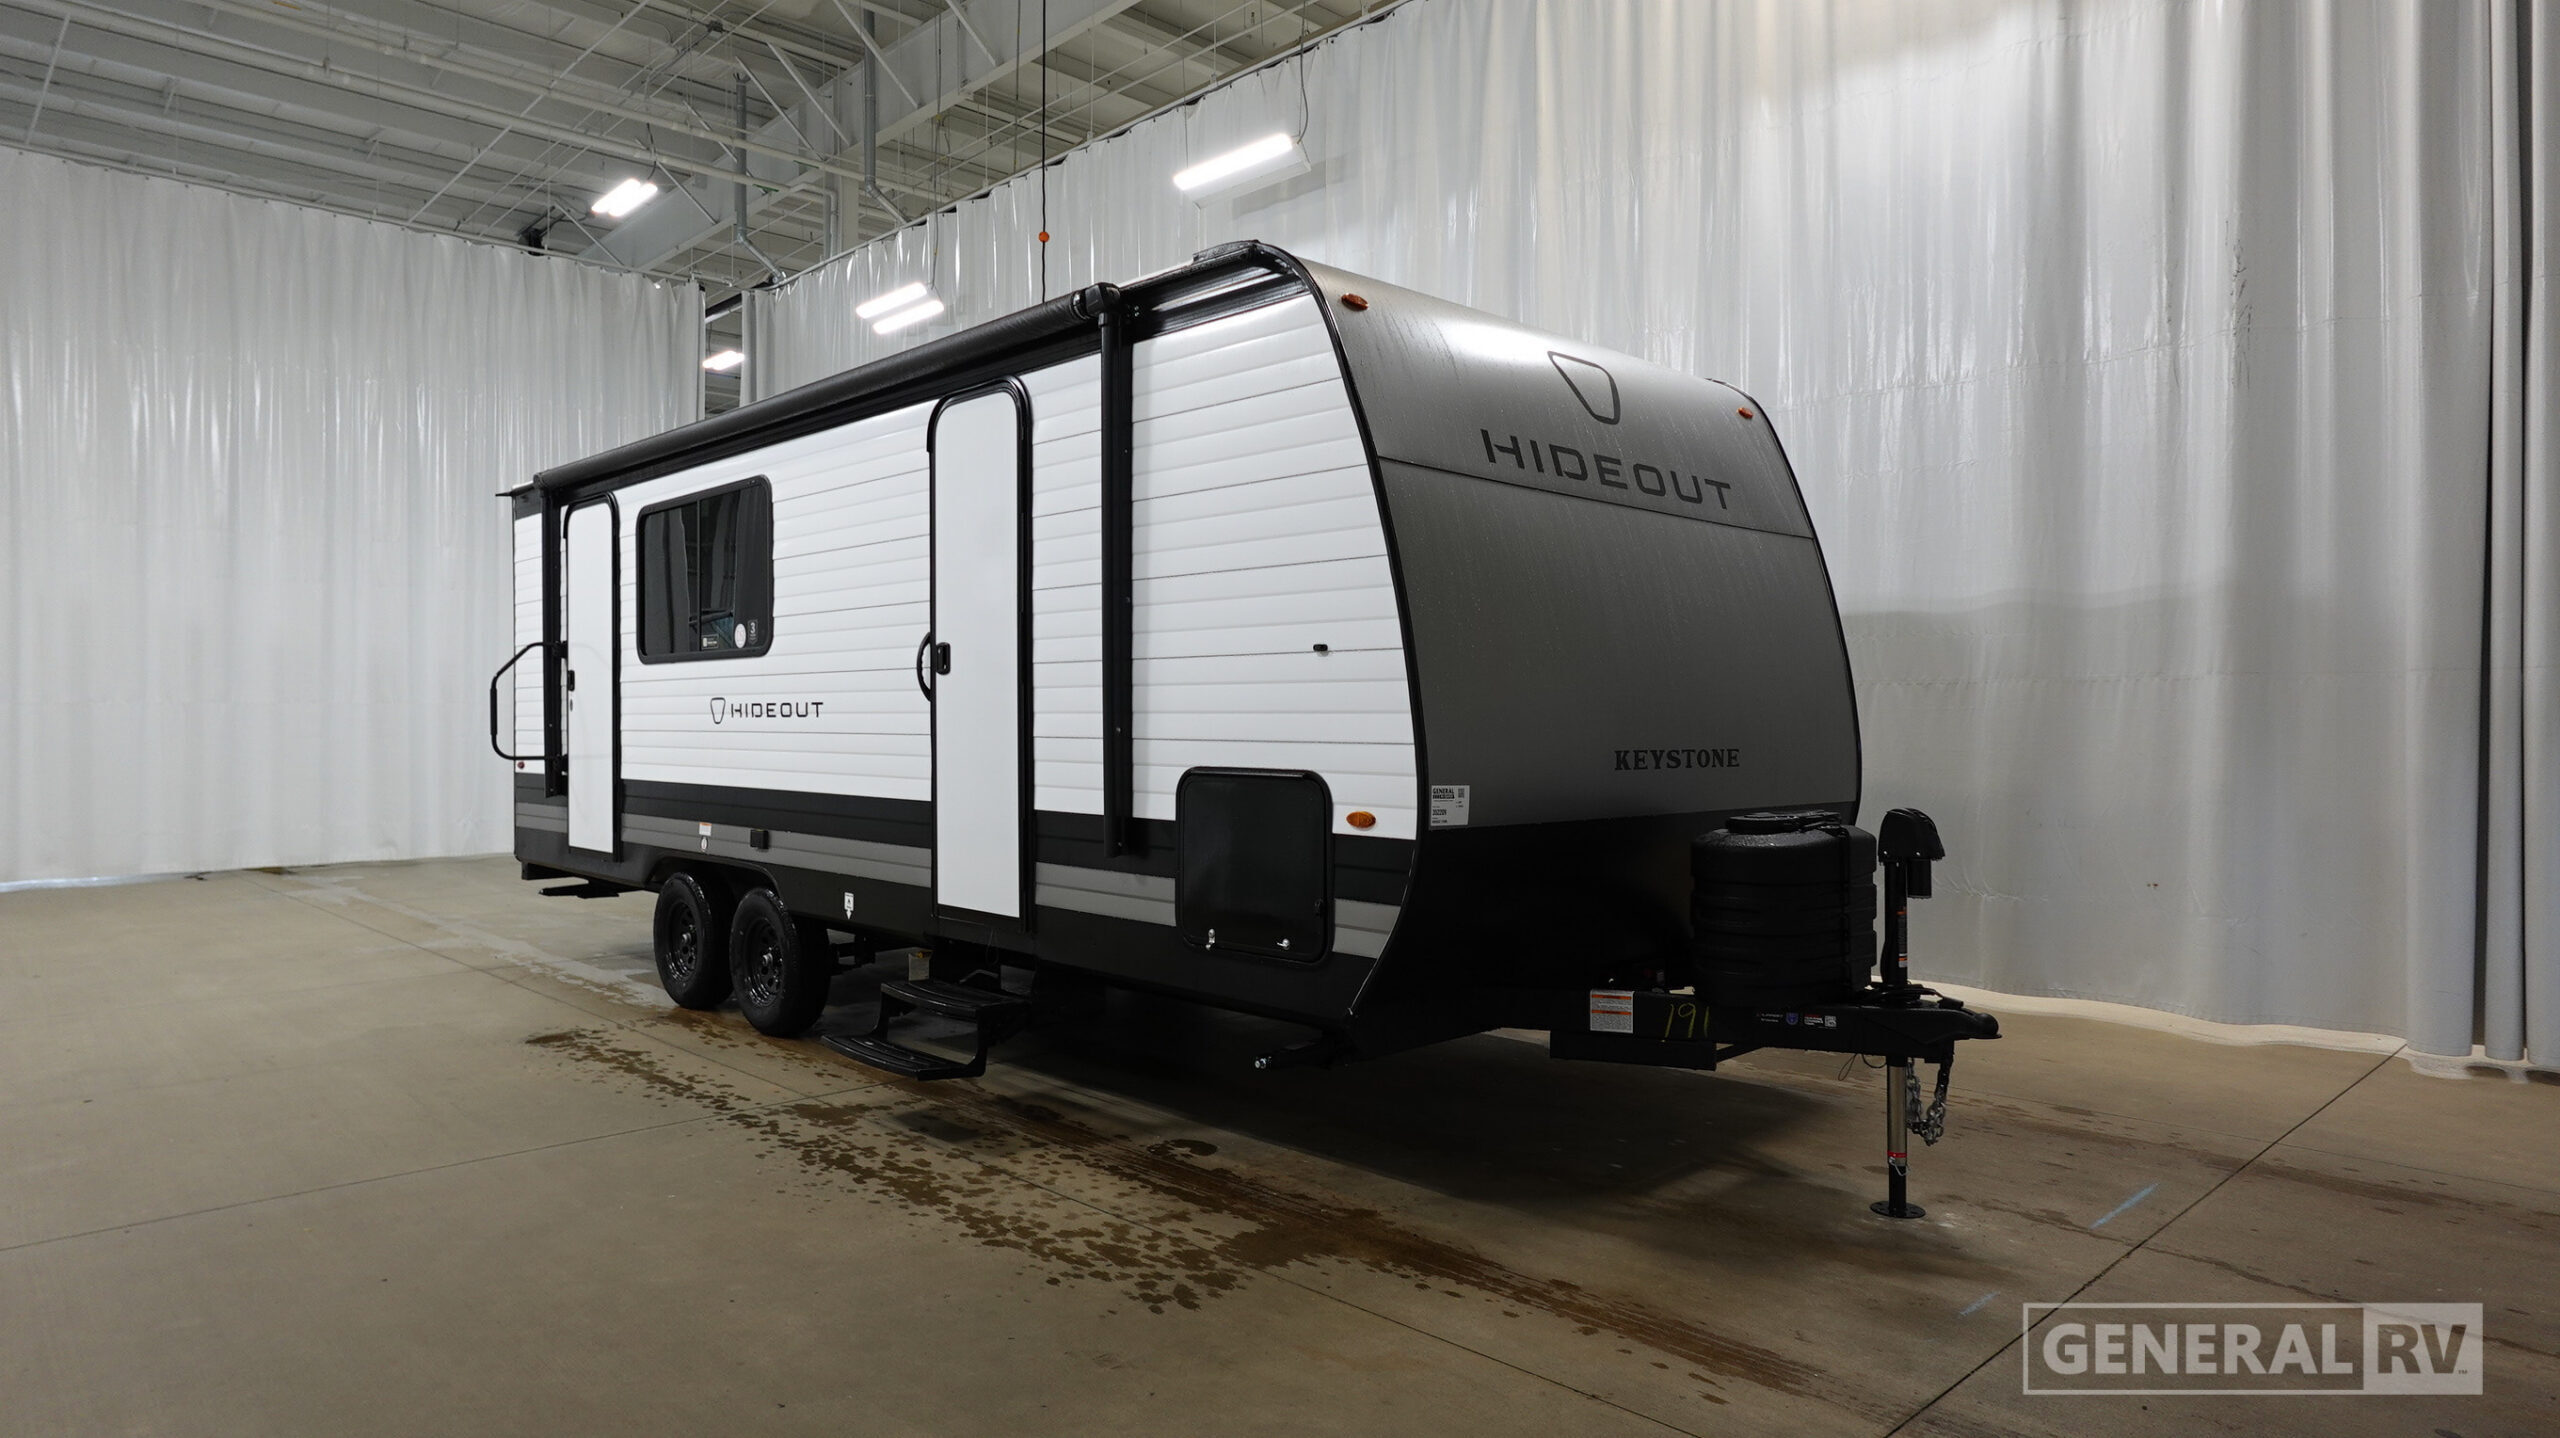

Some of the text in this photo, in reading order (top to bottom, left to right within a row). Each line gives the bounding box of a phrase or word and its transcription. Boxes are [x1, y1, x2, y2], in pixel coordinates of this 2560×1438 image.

[1480, 428, 1731, 510] HIDEOUT
[750, 622, 756, 634] 3
[731, 702, 823, 718] HIDEOUT
[1614, 748, 1740, 771] KEYSTONE
[1664, 1002, 1710, 1038] 191
